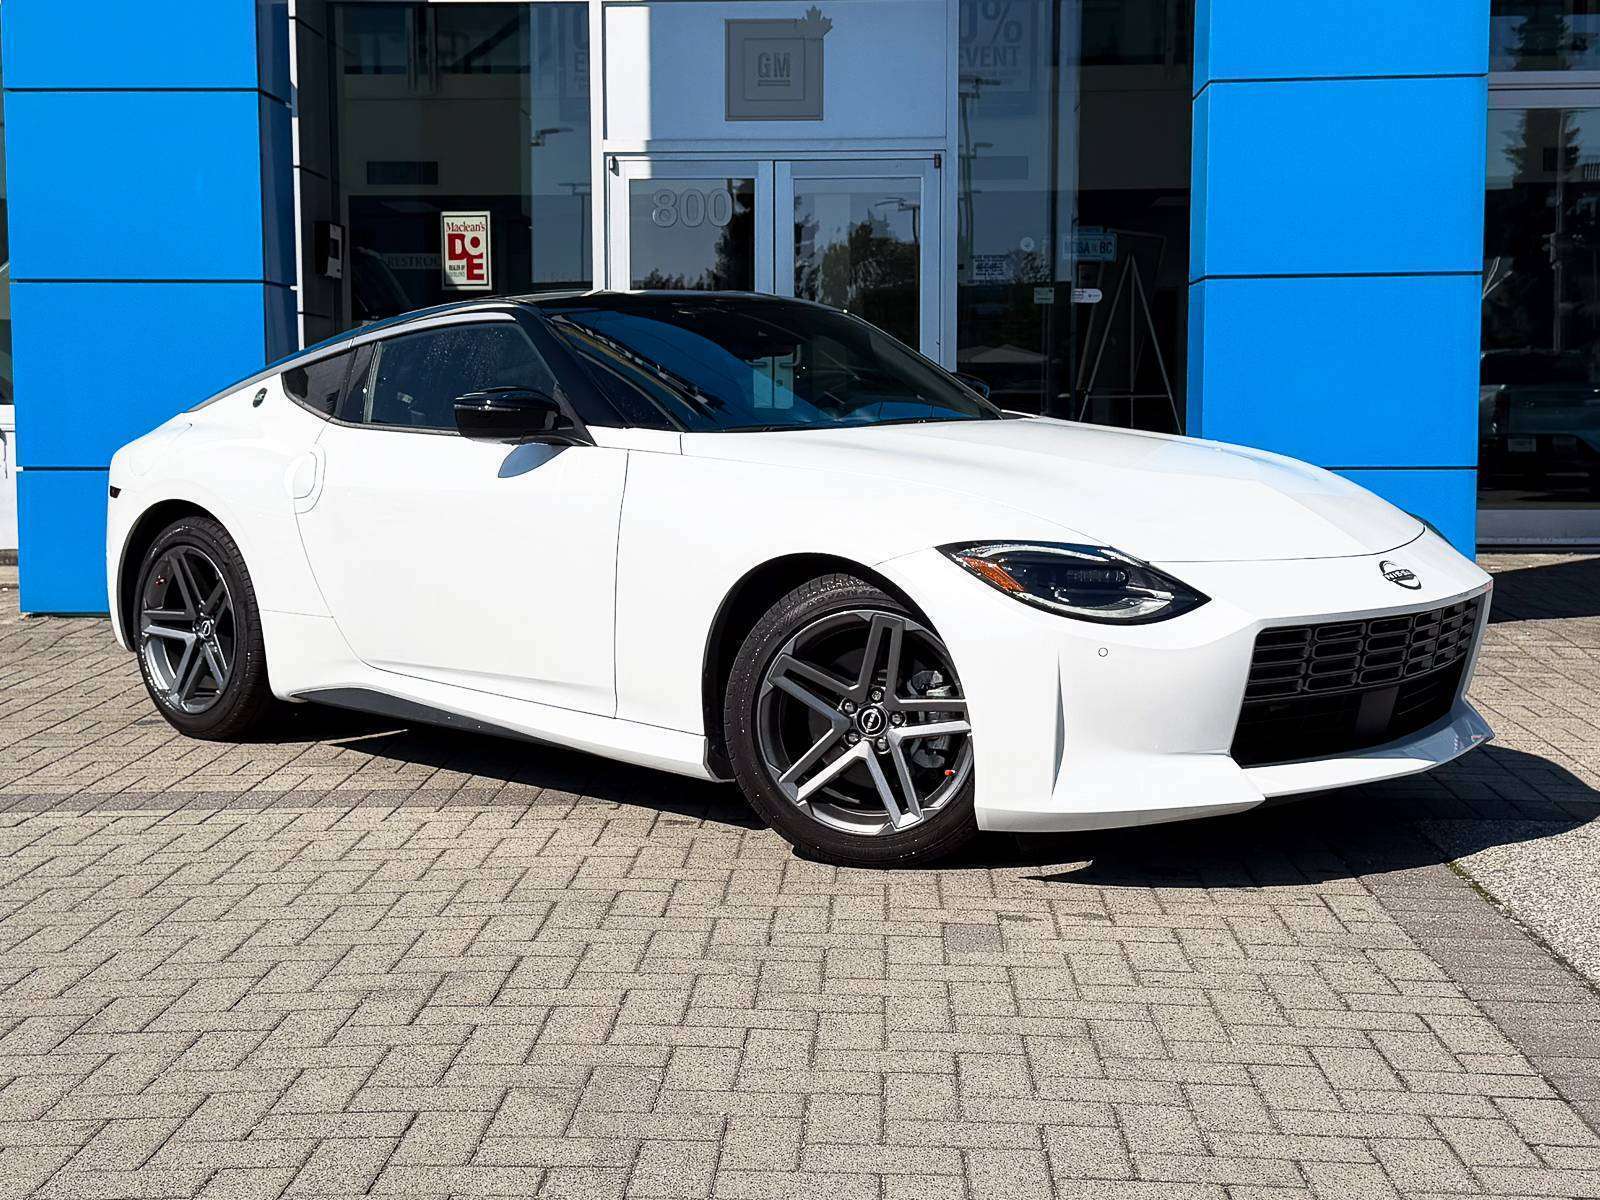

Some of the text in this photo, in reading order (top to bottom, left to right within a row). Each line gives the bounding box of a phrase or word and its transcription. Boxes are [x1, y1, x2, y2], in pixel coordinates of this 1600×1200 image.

[758, 52, 790, 78] GM
[652, 188, 733, 228] 800
[446, 221, 486, 233] Maclean's
